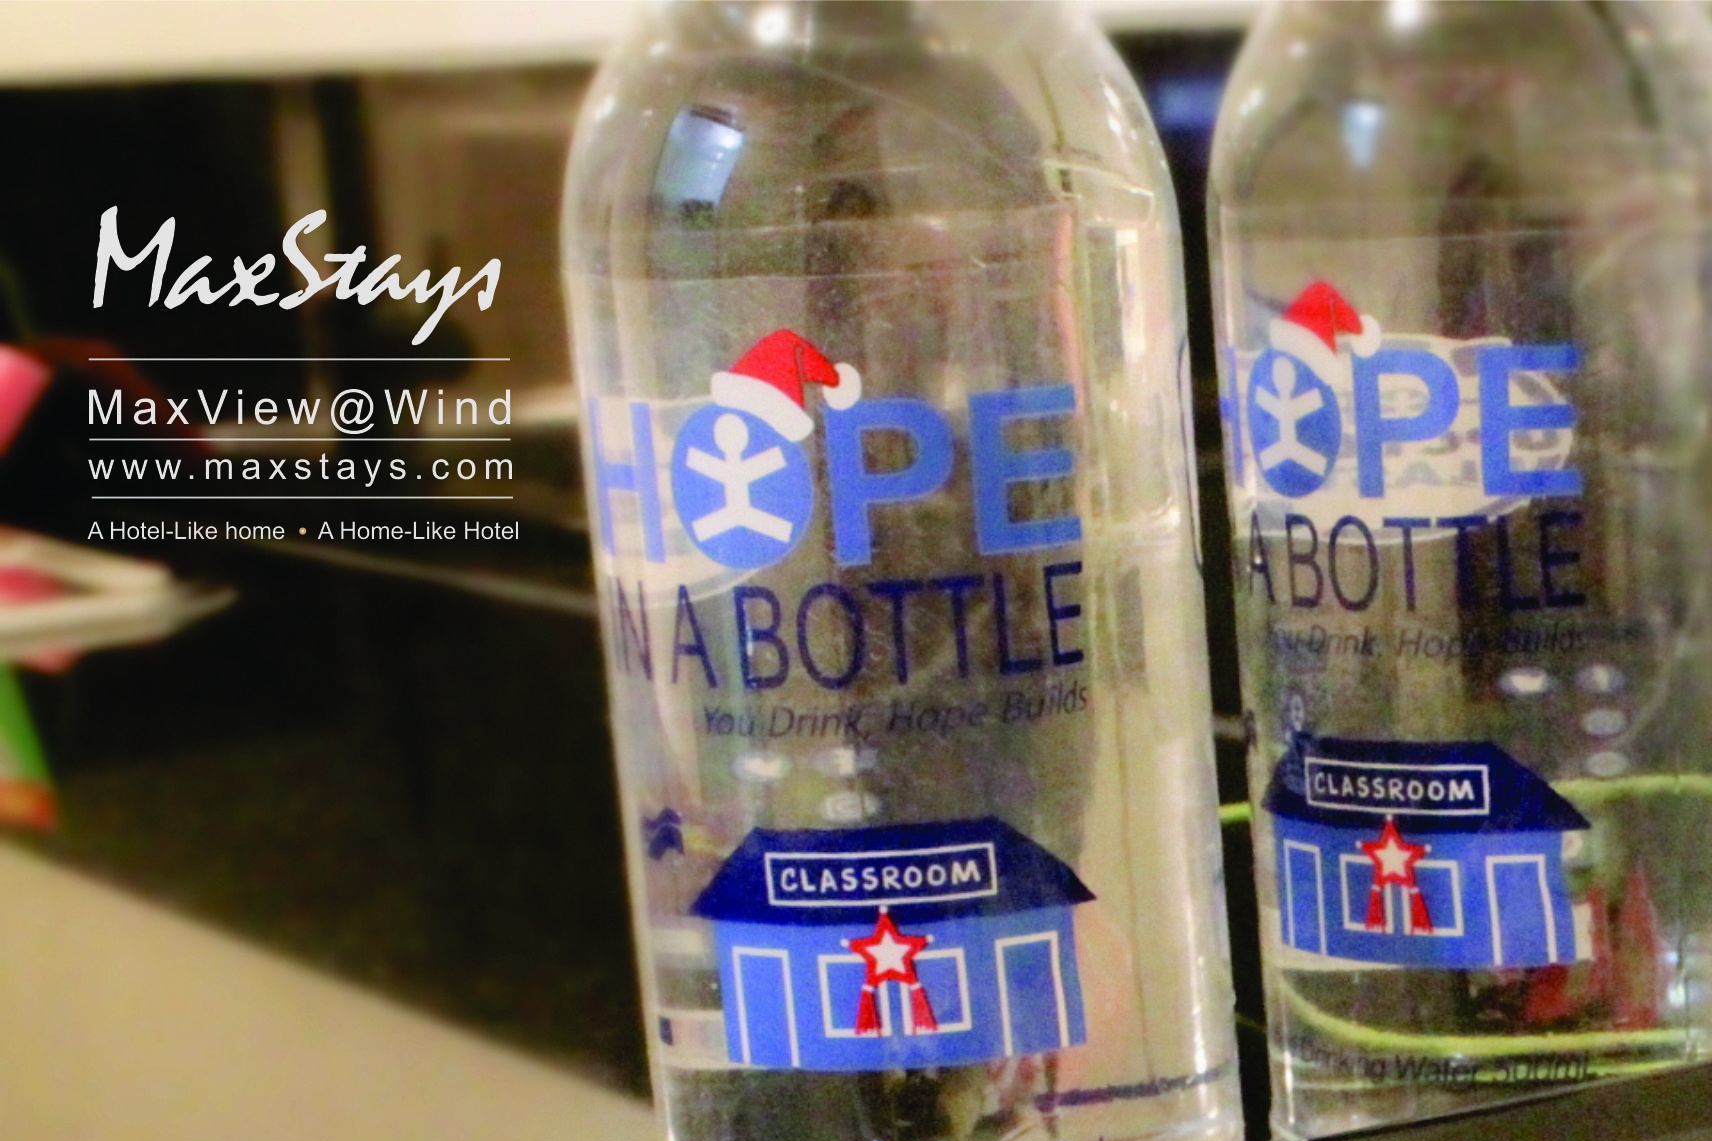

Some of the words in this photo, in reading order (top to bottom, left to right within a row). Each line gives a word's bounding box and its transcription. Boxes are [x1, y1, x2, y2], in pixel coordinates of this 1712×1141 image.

[592, 384, 1082, 570] HOPE
[1285, 510, 1586, 613] BOTTLE
[671, 584, 718, 690] A
[733, 561, 1084, 690] BOTTLE
[704, 704, 756, 737] You
[887, 700, 988, 740] Hope
[1001, 682, 1089, 724] Builds
[1314, 770, 1475, 802] CLASSROOM
[780, 857, 982, 895] CLASSROOM
